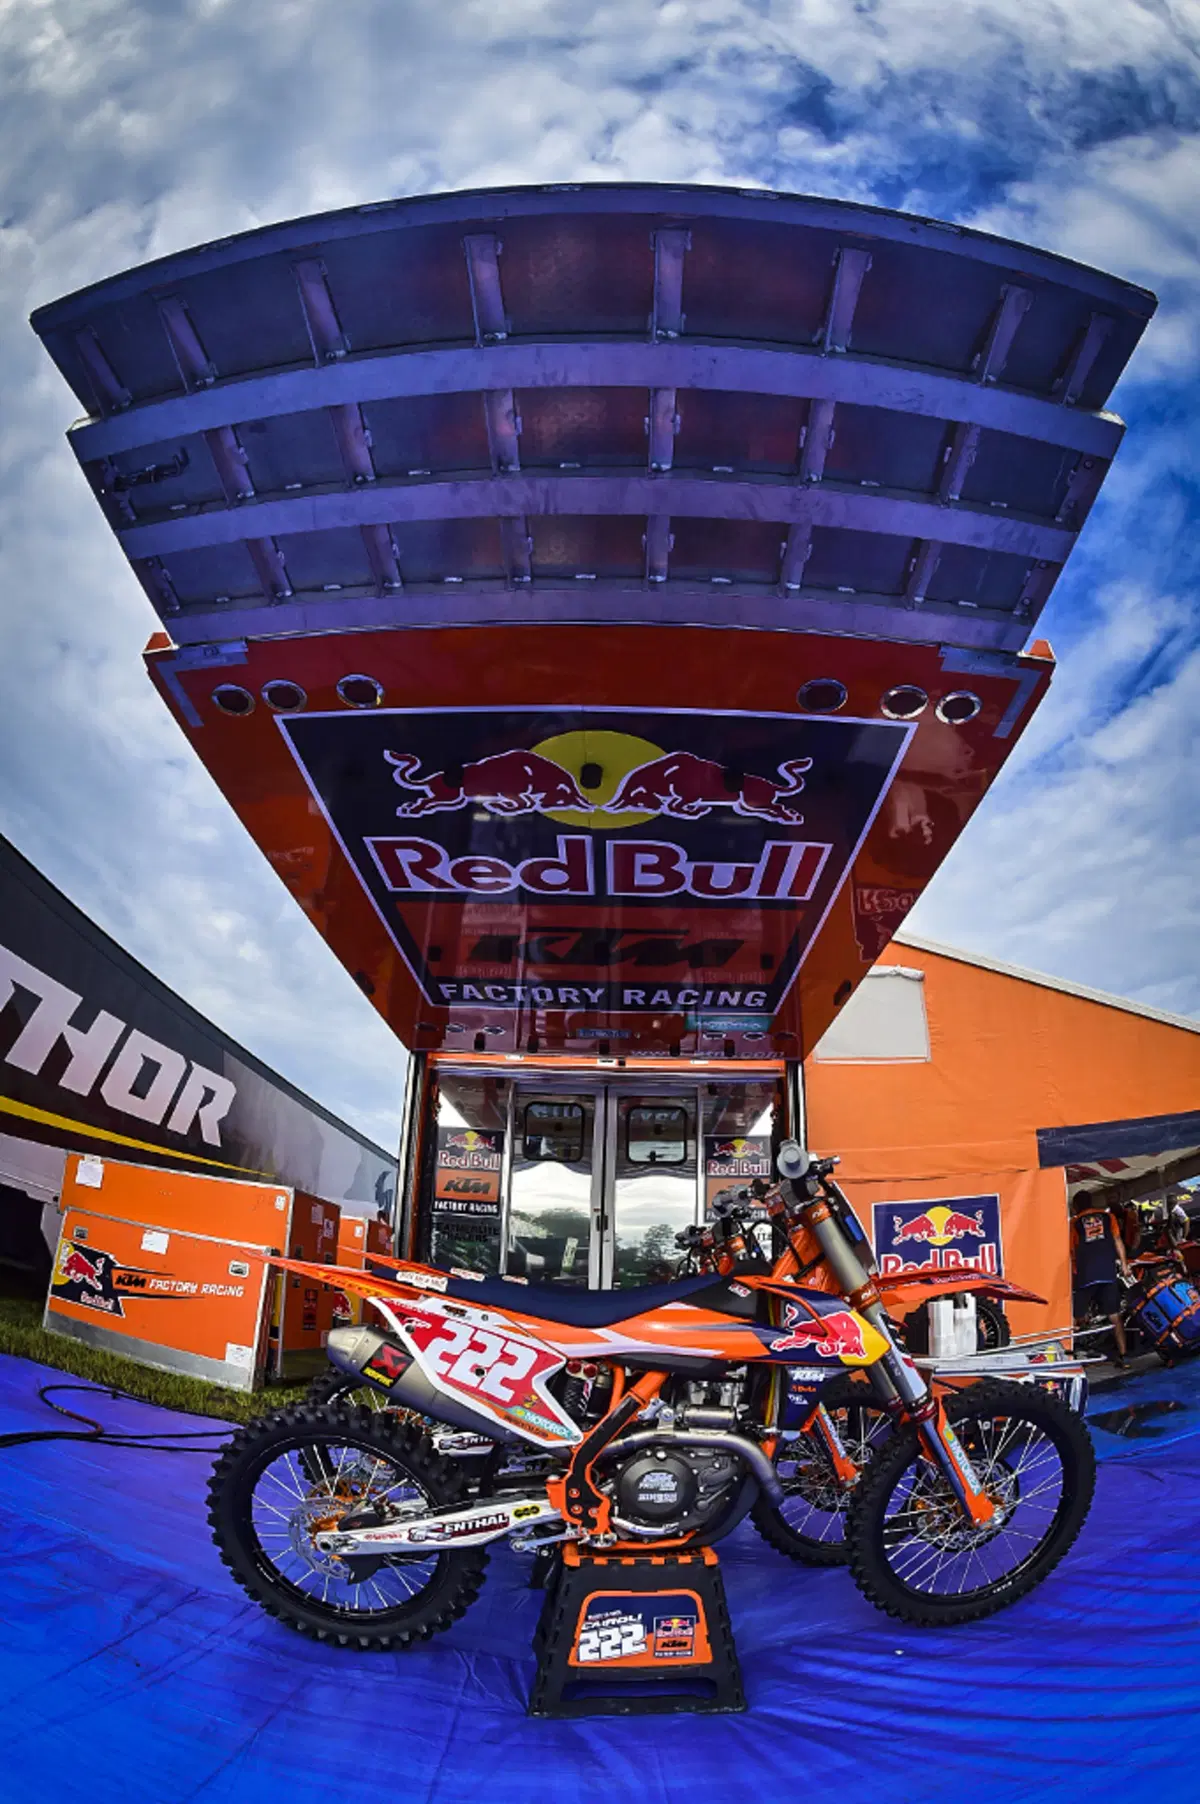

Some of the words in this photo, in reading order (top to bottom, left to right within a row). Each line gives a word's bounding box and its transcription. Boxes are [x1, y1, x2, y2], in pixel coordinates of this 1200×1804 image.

[362, 835, 595, 896] Red
[605, 839, 834, 900] Bull
[466, 926, 745, 969] KTM
[439, 983, 603, 1005] FACTORY
[623, 988, 768, 1008] RACING
[437, 1150, 468, 1168] Red
[470, 1152, 501, 1170] Bull
[707, 1159, 738, 1175] Red
[740, 1159, 770, 1175] Bull
[444, 1177, 491, 1194] KTM
[880, 1249, 940, 1277] Red
[942, 1243, 998, 1274] Bull
[115, 1273, 147, 1288] KTM
[149, 1278, 198, 1295] FACTORY
[200, 1284, 244, 1298] RACING
[424, 1316, 539, 1402] 222
[578, 1623, 648, 1662] 222
